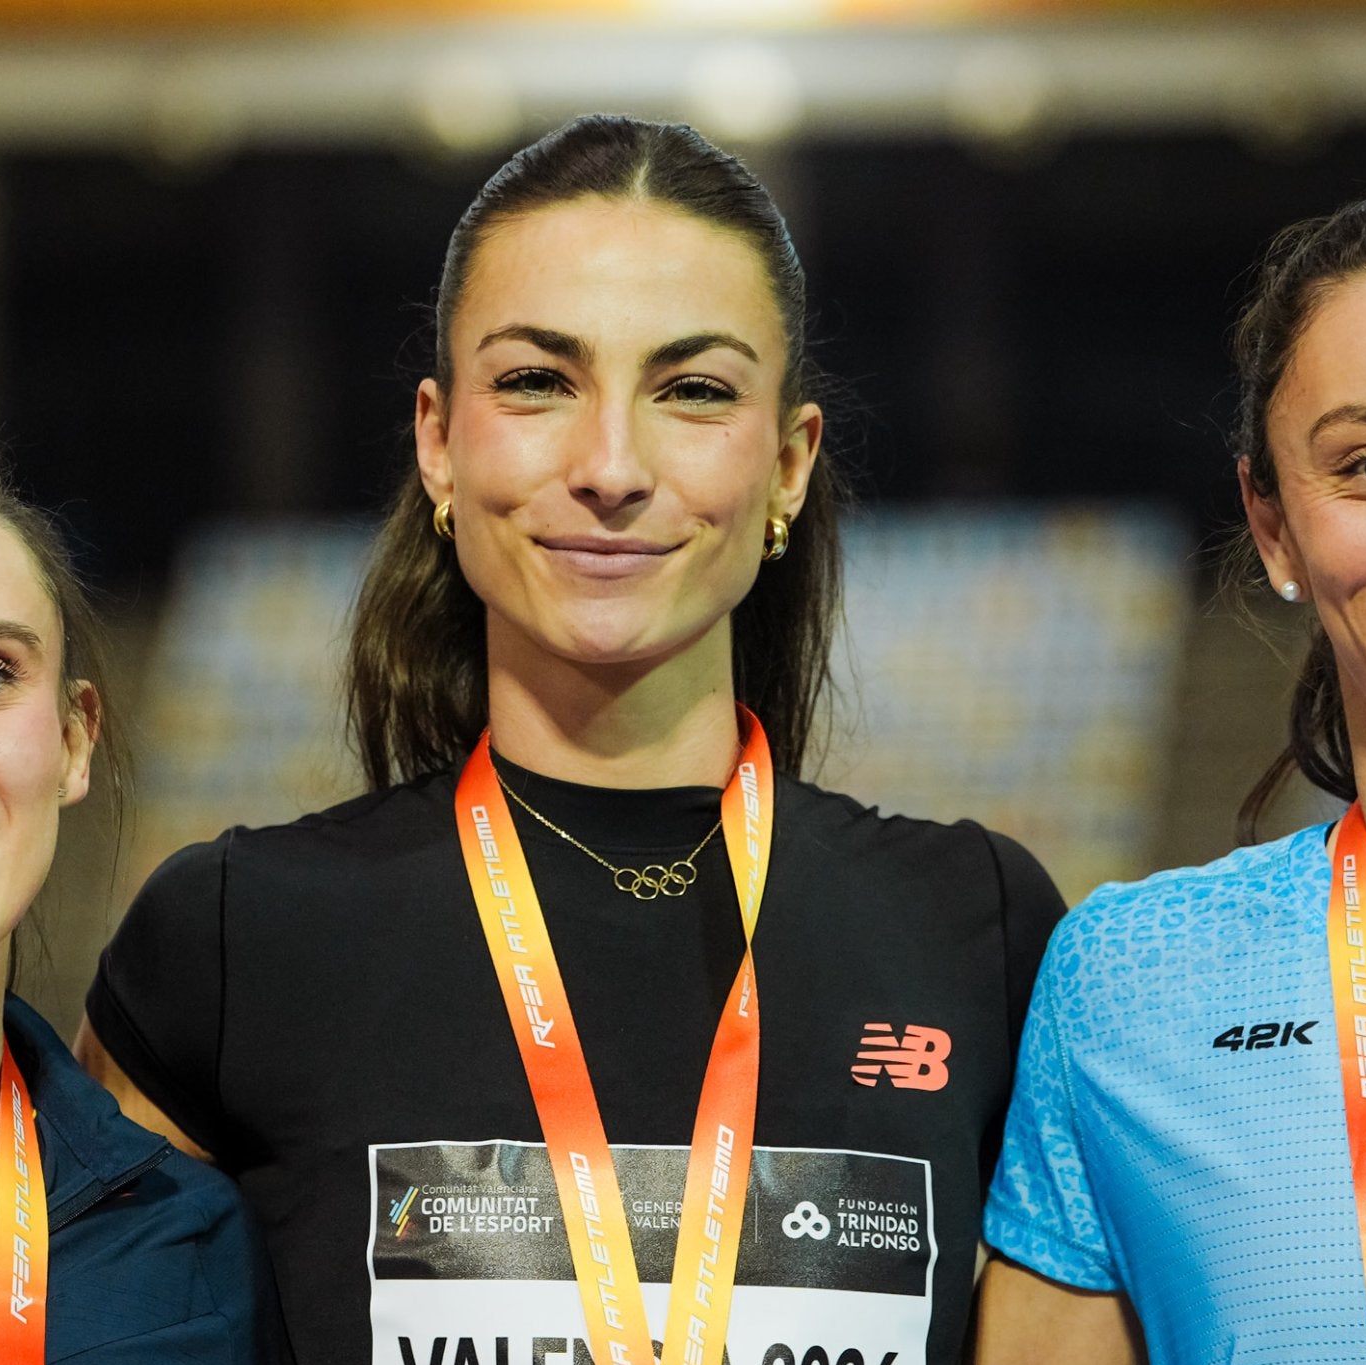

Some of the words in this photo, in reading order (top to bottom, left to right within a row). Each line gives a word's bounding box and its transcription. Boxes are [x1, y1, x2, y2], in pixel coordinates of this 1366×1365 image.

[471, 805, 528, 954] ATLETISMO
[1213, 1020, 1320, 1051] 42K
[10, 1080, 32, 1231] ATLETISMO
[421, 1184, 477, 1196] Comunitat
[421, 1197, 539, 1215] COMUNITAT
[696, 1124, 734, 1309] ATLETISMO
[838, 1198, 918, 1216] FUNDACIÓN
[429, 1216, 453, 1234] DE
[460, 1216, 554, 1234] L'ESPORT
[837, 1212, 919, 1236] TRINIDAD
[569, 1151, 623, 1331] ATLETISMO
[837, 1232, 921, 1252] ALFONSO
